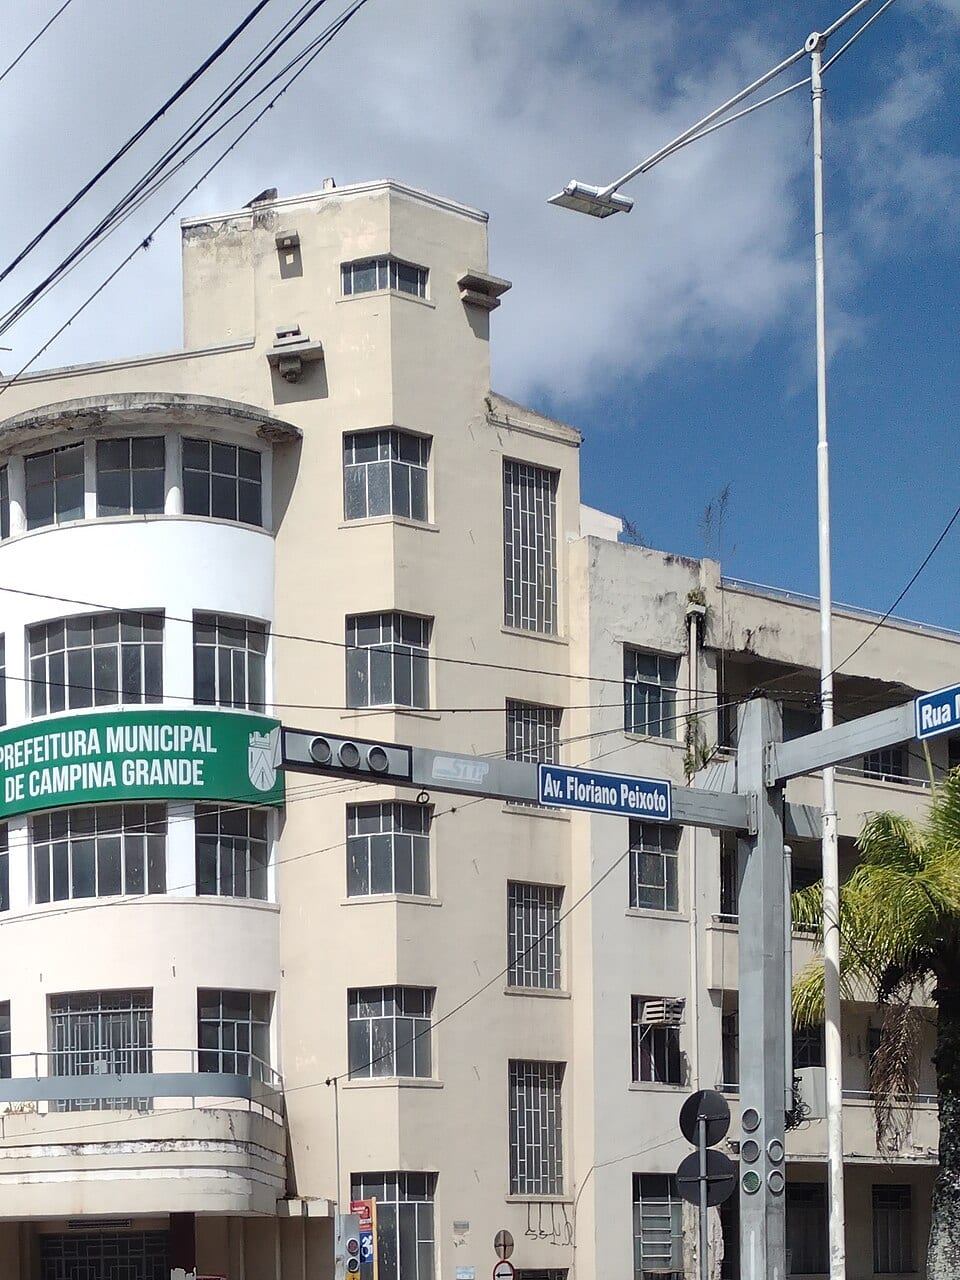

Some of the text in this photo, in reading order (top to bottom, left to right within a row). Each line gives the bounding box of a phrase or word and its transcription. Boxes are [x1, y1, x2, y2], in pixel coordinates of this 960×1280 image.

[921, 703, 951, 730] Rua
[106, 725, 217, 754] MUNICIPAL
[4, 758, 204, 803] DE CAMPINA GRANDE
[543, 773, 667, 812] Av. Floriano Peixoto
